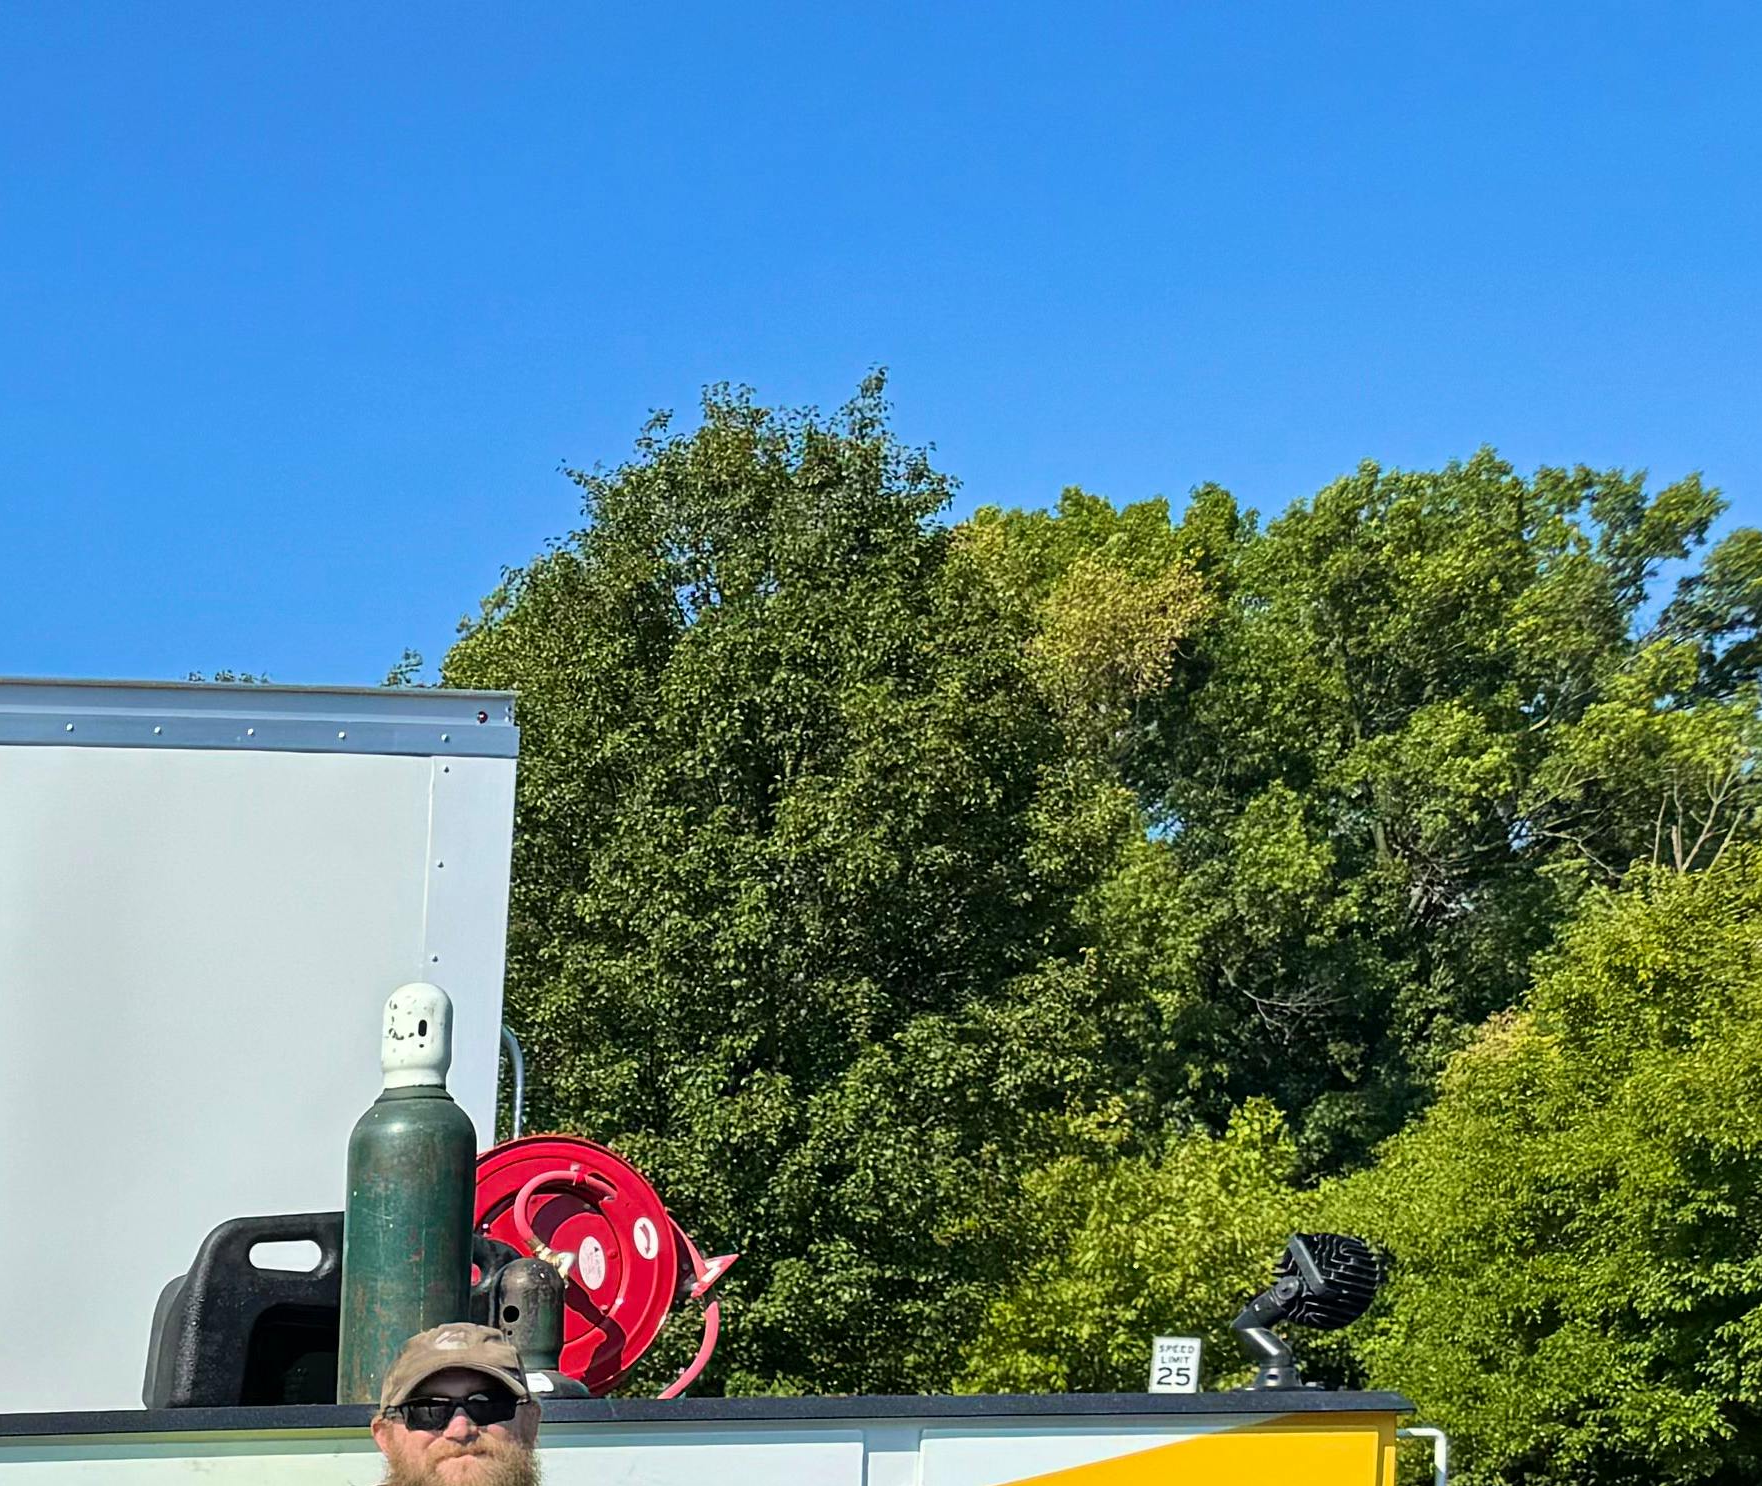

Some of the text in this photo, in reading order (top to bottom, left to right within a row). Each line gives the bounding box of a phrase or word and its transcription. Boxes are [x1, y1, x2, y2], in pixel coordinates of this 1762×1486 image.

[1158, 1344, 1195, 1354] SPEED
[1160, 1356, 1190, 1364] LIMIT
[1156, 1366, 1190, 1386] 25
